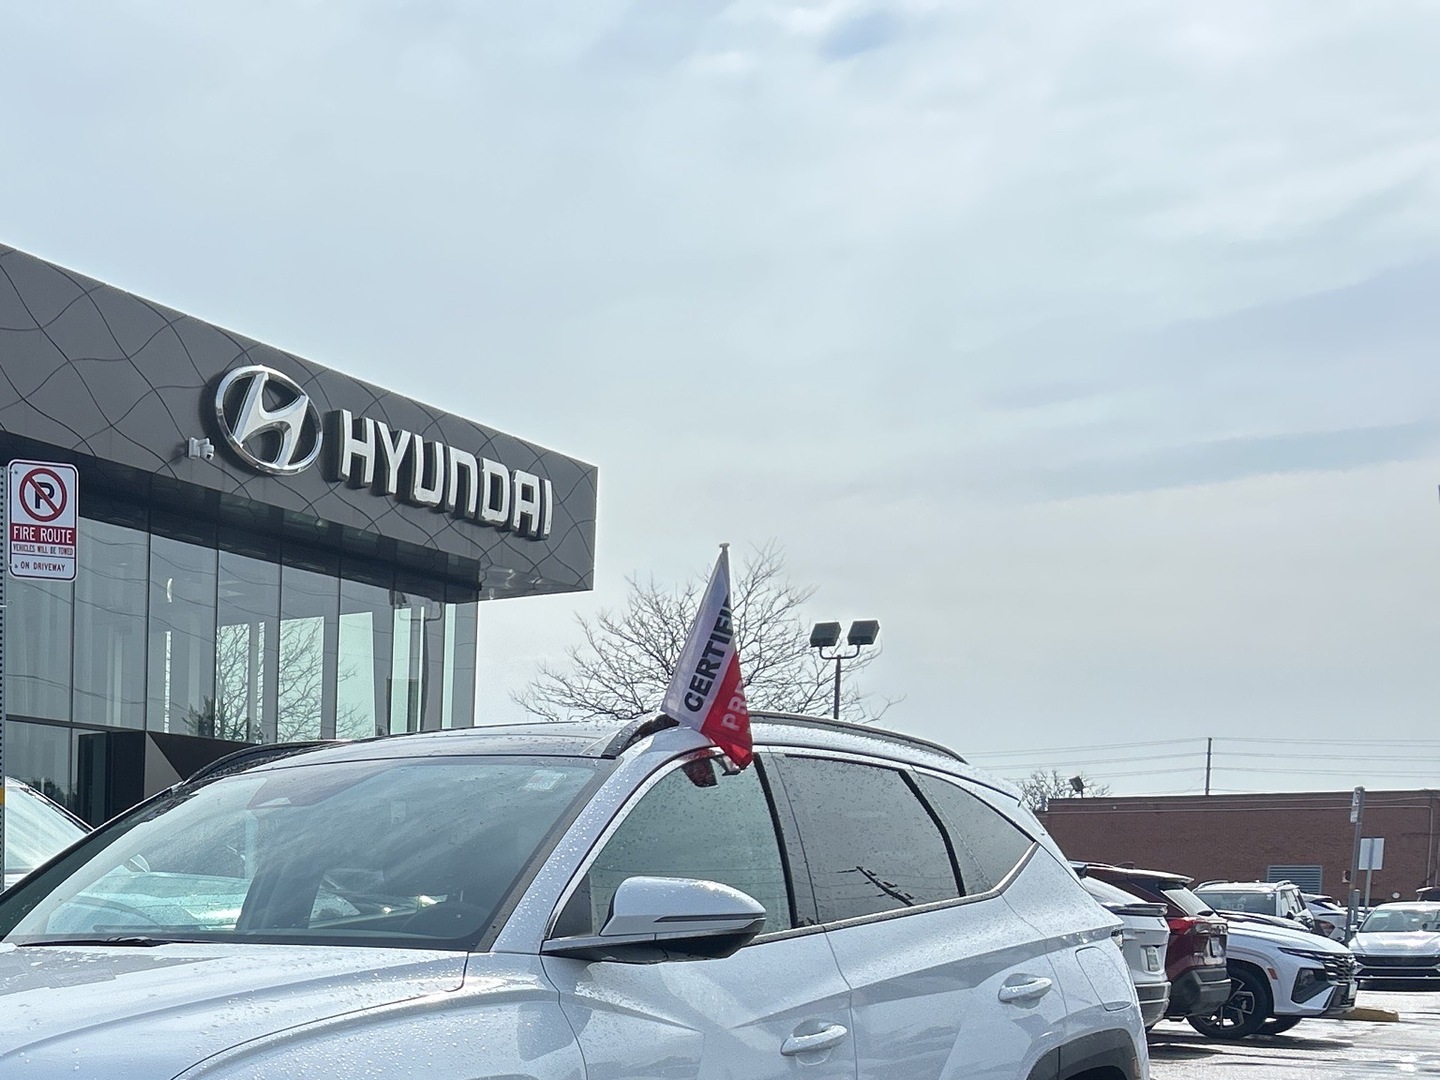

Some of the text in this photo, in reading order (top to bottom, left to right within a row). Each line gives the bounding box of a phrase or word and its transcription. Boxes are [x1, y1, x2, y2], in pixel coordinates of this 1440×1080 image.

[339, 409, 553, 541] HYUNDAI
[13, 525, 73, 544] FIRE ROUTE
[13, 543, 73, 555] VEHICLES WILL BE TOWED
[21, 561, 65, 572] ON DRIVEWAY
